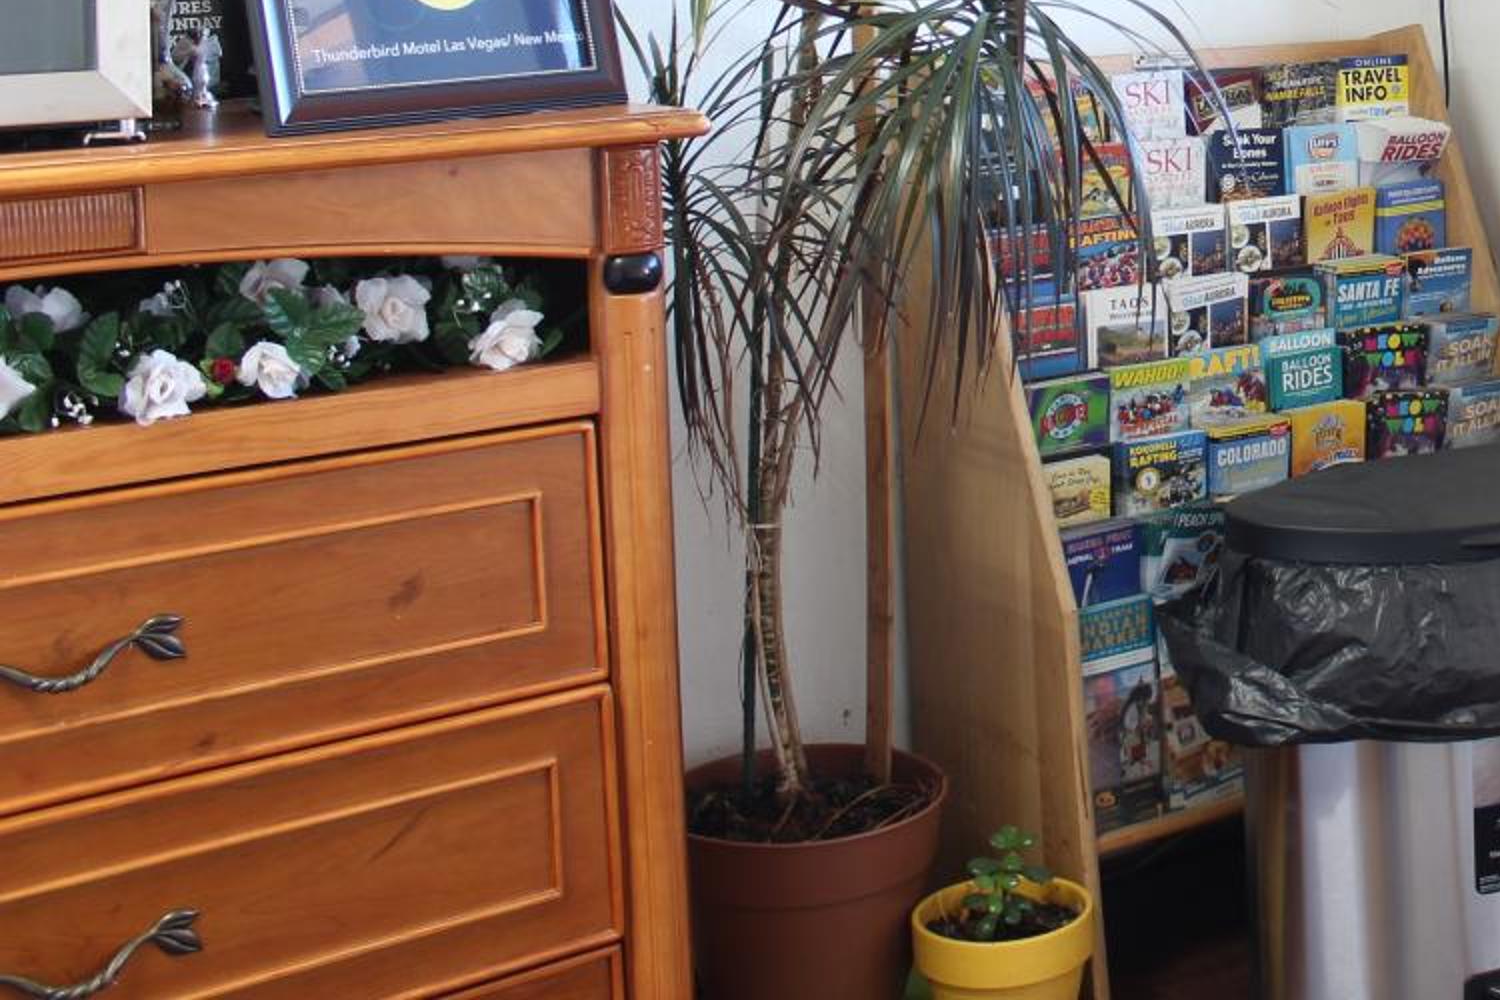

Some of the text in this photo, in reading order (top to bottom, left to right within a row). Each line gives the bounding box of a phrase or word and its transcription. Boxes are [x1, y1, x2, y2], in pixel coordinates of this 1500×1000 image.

[314, 42, 400, 64] Thunderbird
[403, 40, 441, 56] Motel
[443, 39, 466, 52] Las
[512, 33, 542, 47] New
[1342, 68, 1402, 86] TRAVEL
[1126, 80, 1170, 106] SKI
[1345, 85, 1388, 102] INFO
[1251, 133, 1277, 145] Your
[1388, 131, 1445, 145] BALLOON
[1147, 146, 1192, 174] SKI
[1381, 143, 1442, 162] RIDES
[1337, 278, 1400, 303] SANTA FE
[1108, 296, 1149, 310] TAOS
[1449, 336, 1492, 356] SOAK
[1281, 354, 1332, 373] BALLOON
[1282, 365, 1333, 391] RIDES
[1217, 439, 1287, 467] COLORADO
